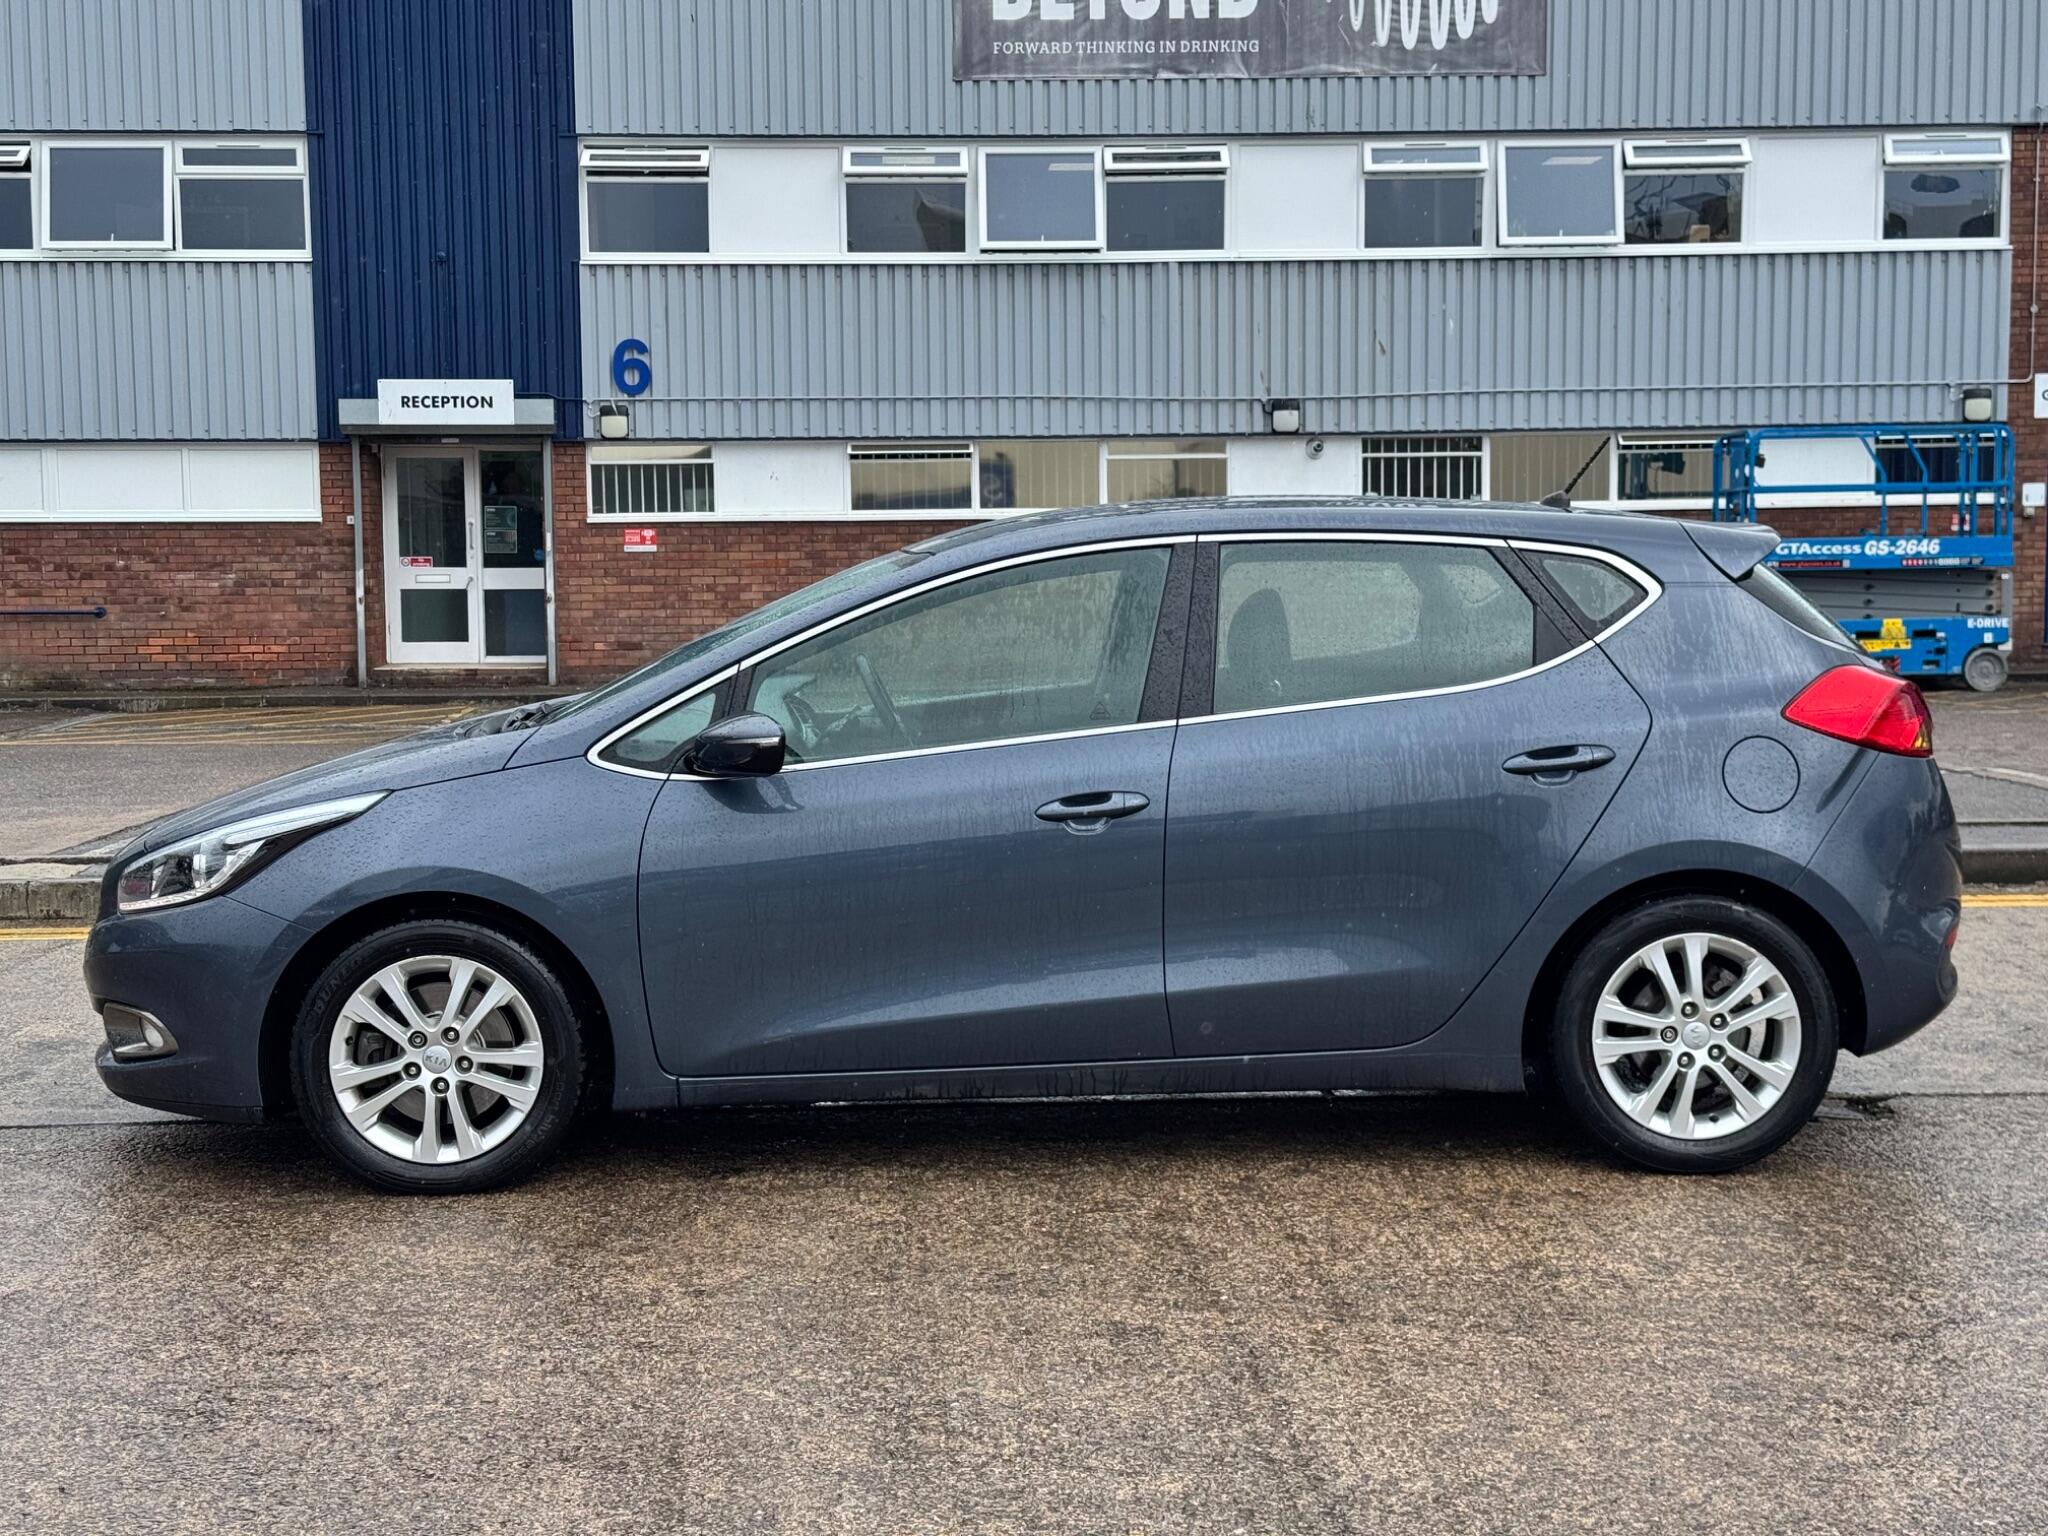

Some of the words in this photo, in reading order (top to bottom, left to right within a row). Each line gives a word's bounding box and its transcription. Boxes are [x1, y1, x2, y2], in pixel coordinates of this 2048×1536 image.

[992, 42, 1073, 55] FORWARD
[1075, 41, 1156, 54] THINKING
[1159, 41, 1176, 54] IN
[1180, 40, 1260, 54] DRINKING
[612, 338, 651, 396] 6
[400, 395, 494, 409] RECEPTION
[1775, 542, 1862, 555] GTAccess
[1864, 539, 1940, 555] GS-2646
[1967, 617, 2009, 628] E-DRIVE
[425, 1055, 448, 1067] KIA
